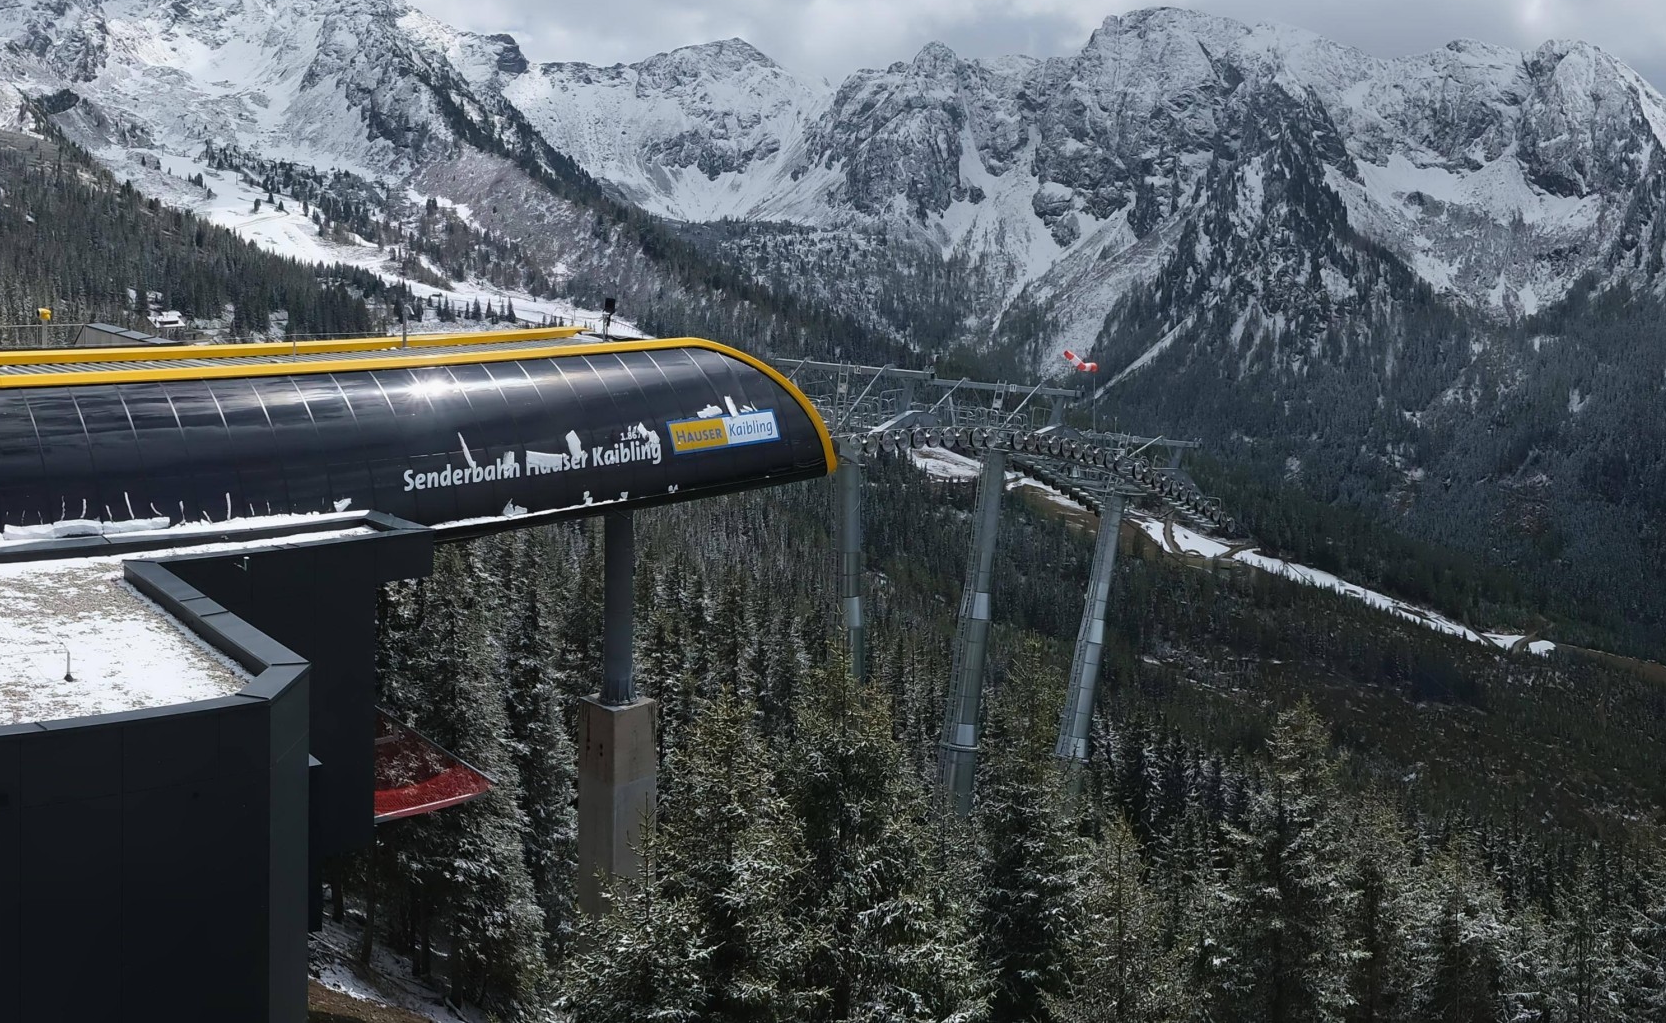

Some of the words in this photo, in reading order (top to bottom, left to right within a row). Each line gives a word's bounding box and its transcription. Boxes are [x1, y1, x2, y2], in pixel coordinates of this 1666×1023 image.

[676, 427, 723, 444] HAUSER
[729, 419, 773, 438] Kaibling
[404, 457, 520, 491] Senderbahn
[592, 440, 662, 467] Kaibling
